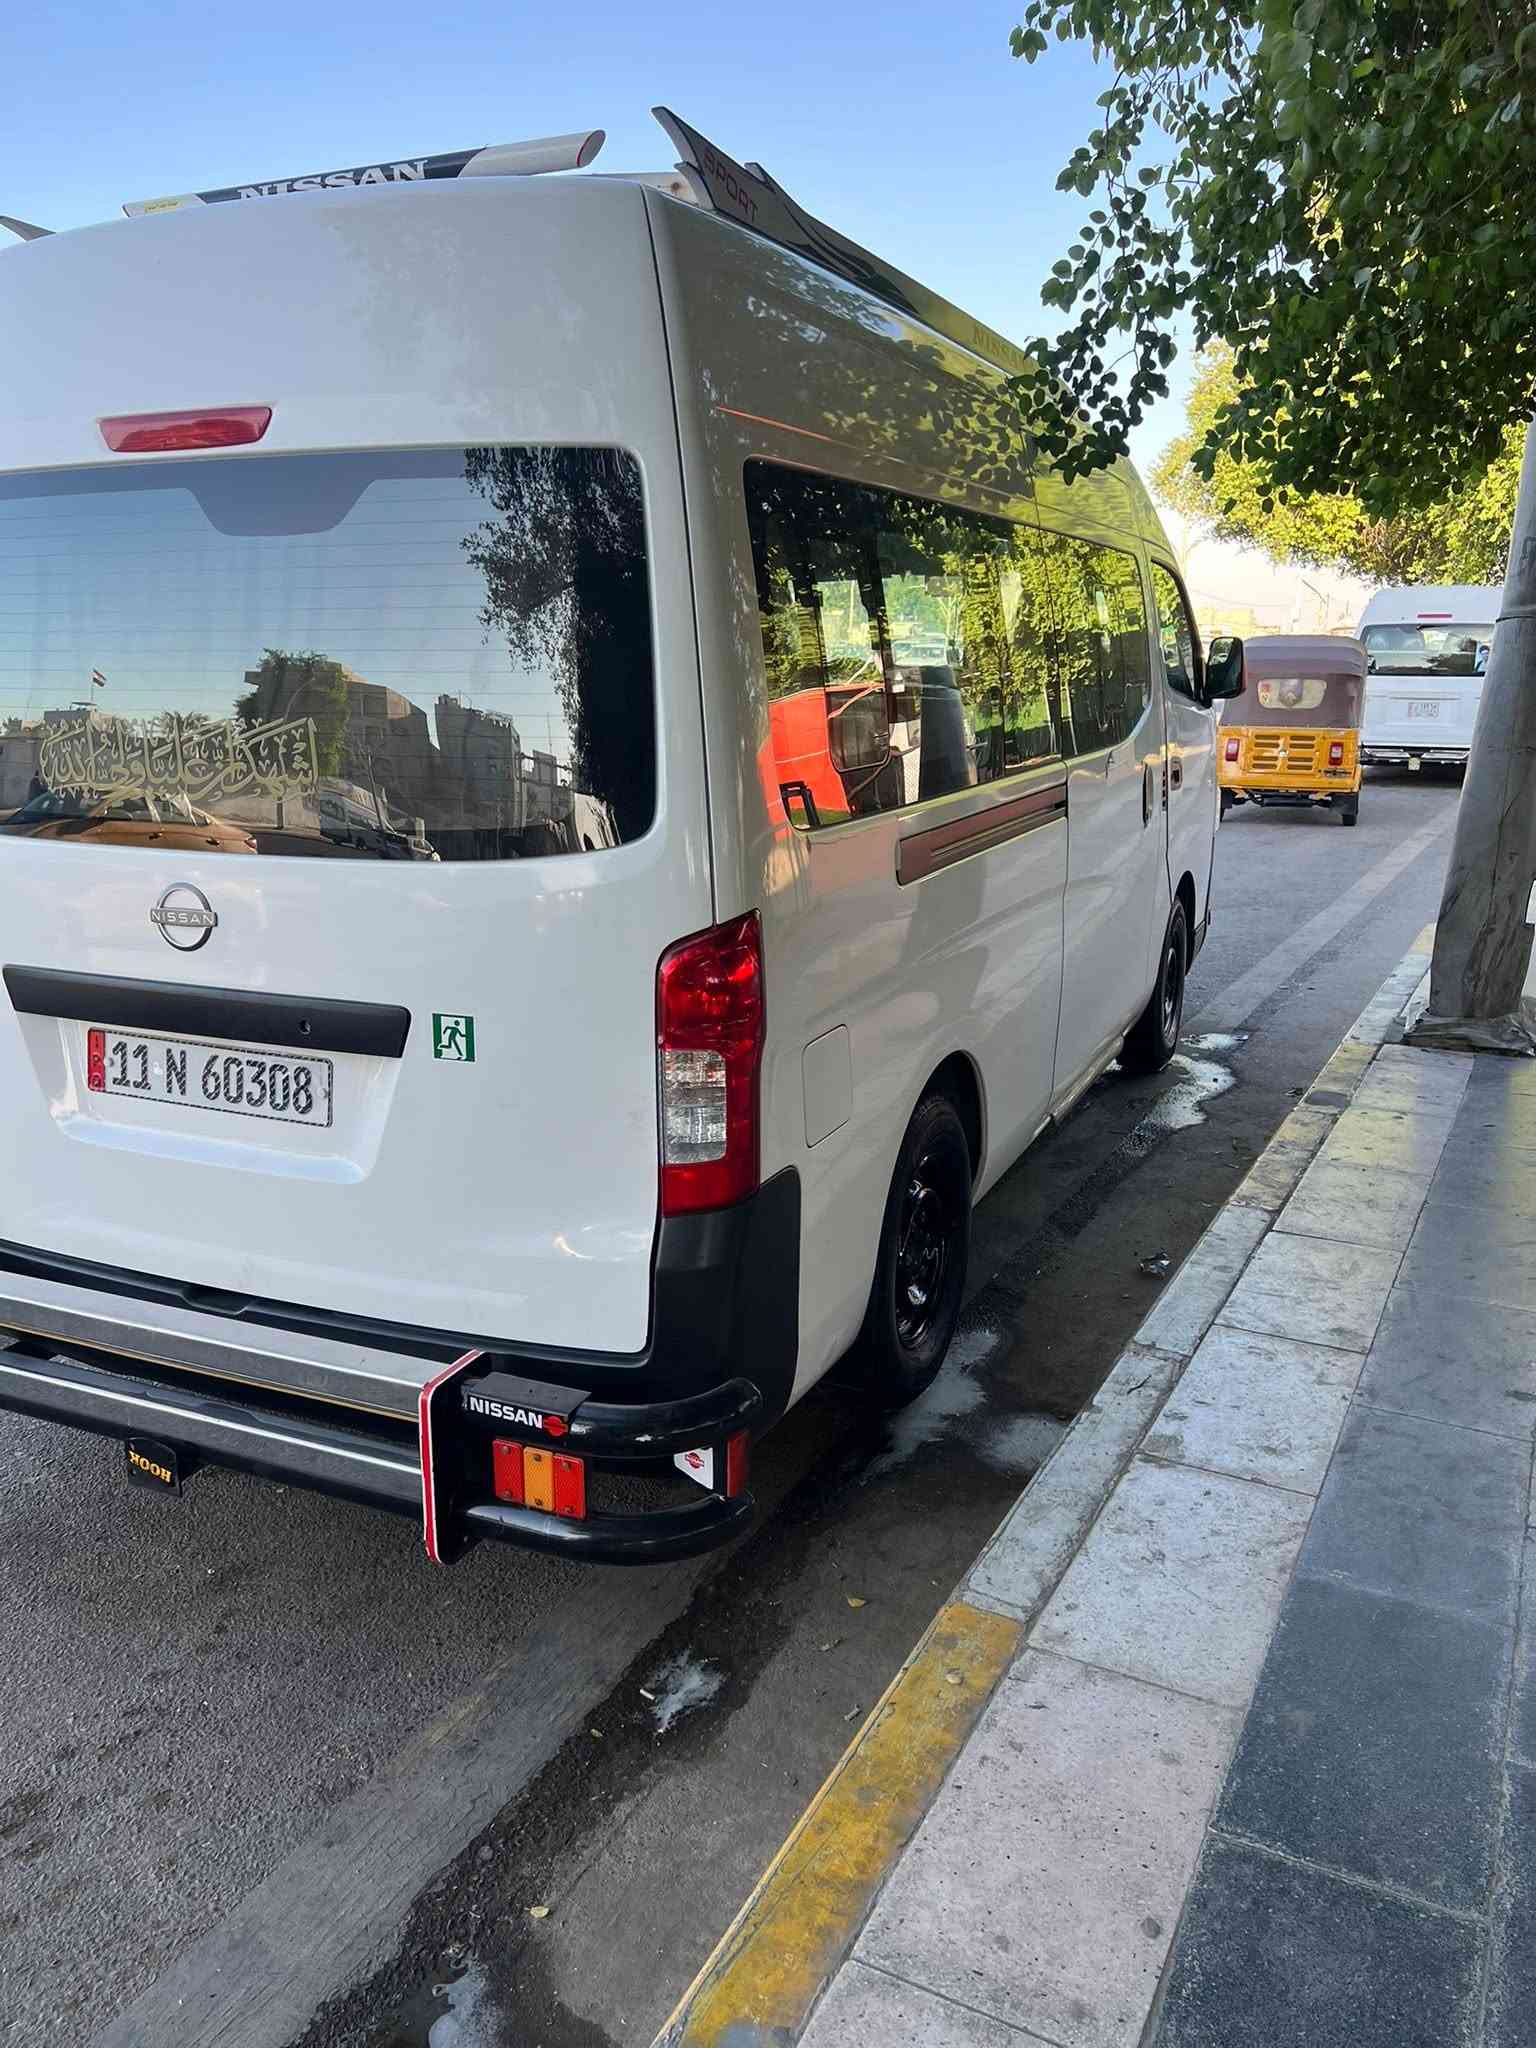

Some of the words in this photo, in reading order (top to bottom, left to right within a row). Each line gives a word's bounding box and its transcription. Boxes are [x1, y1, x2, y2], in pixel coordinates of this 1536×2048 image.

[703, 146, 758, 221] SPORT
[151, 910, 215, 925] NISSAN
[112, 1041, 151, 1090] 11
[165, 1048, 187, 1096] N
[201, 1054, 313, 1114] 60308
[469, 1396, 543, 1429] NISSAN
